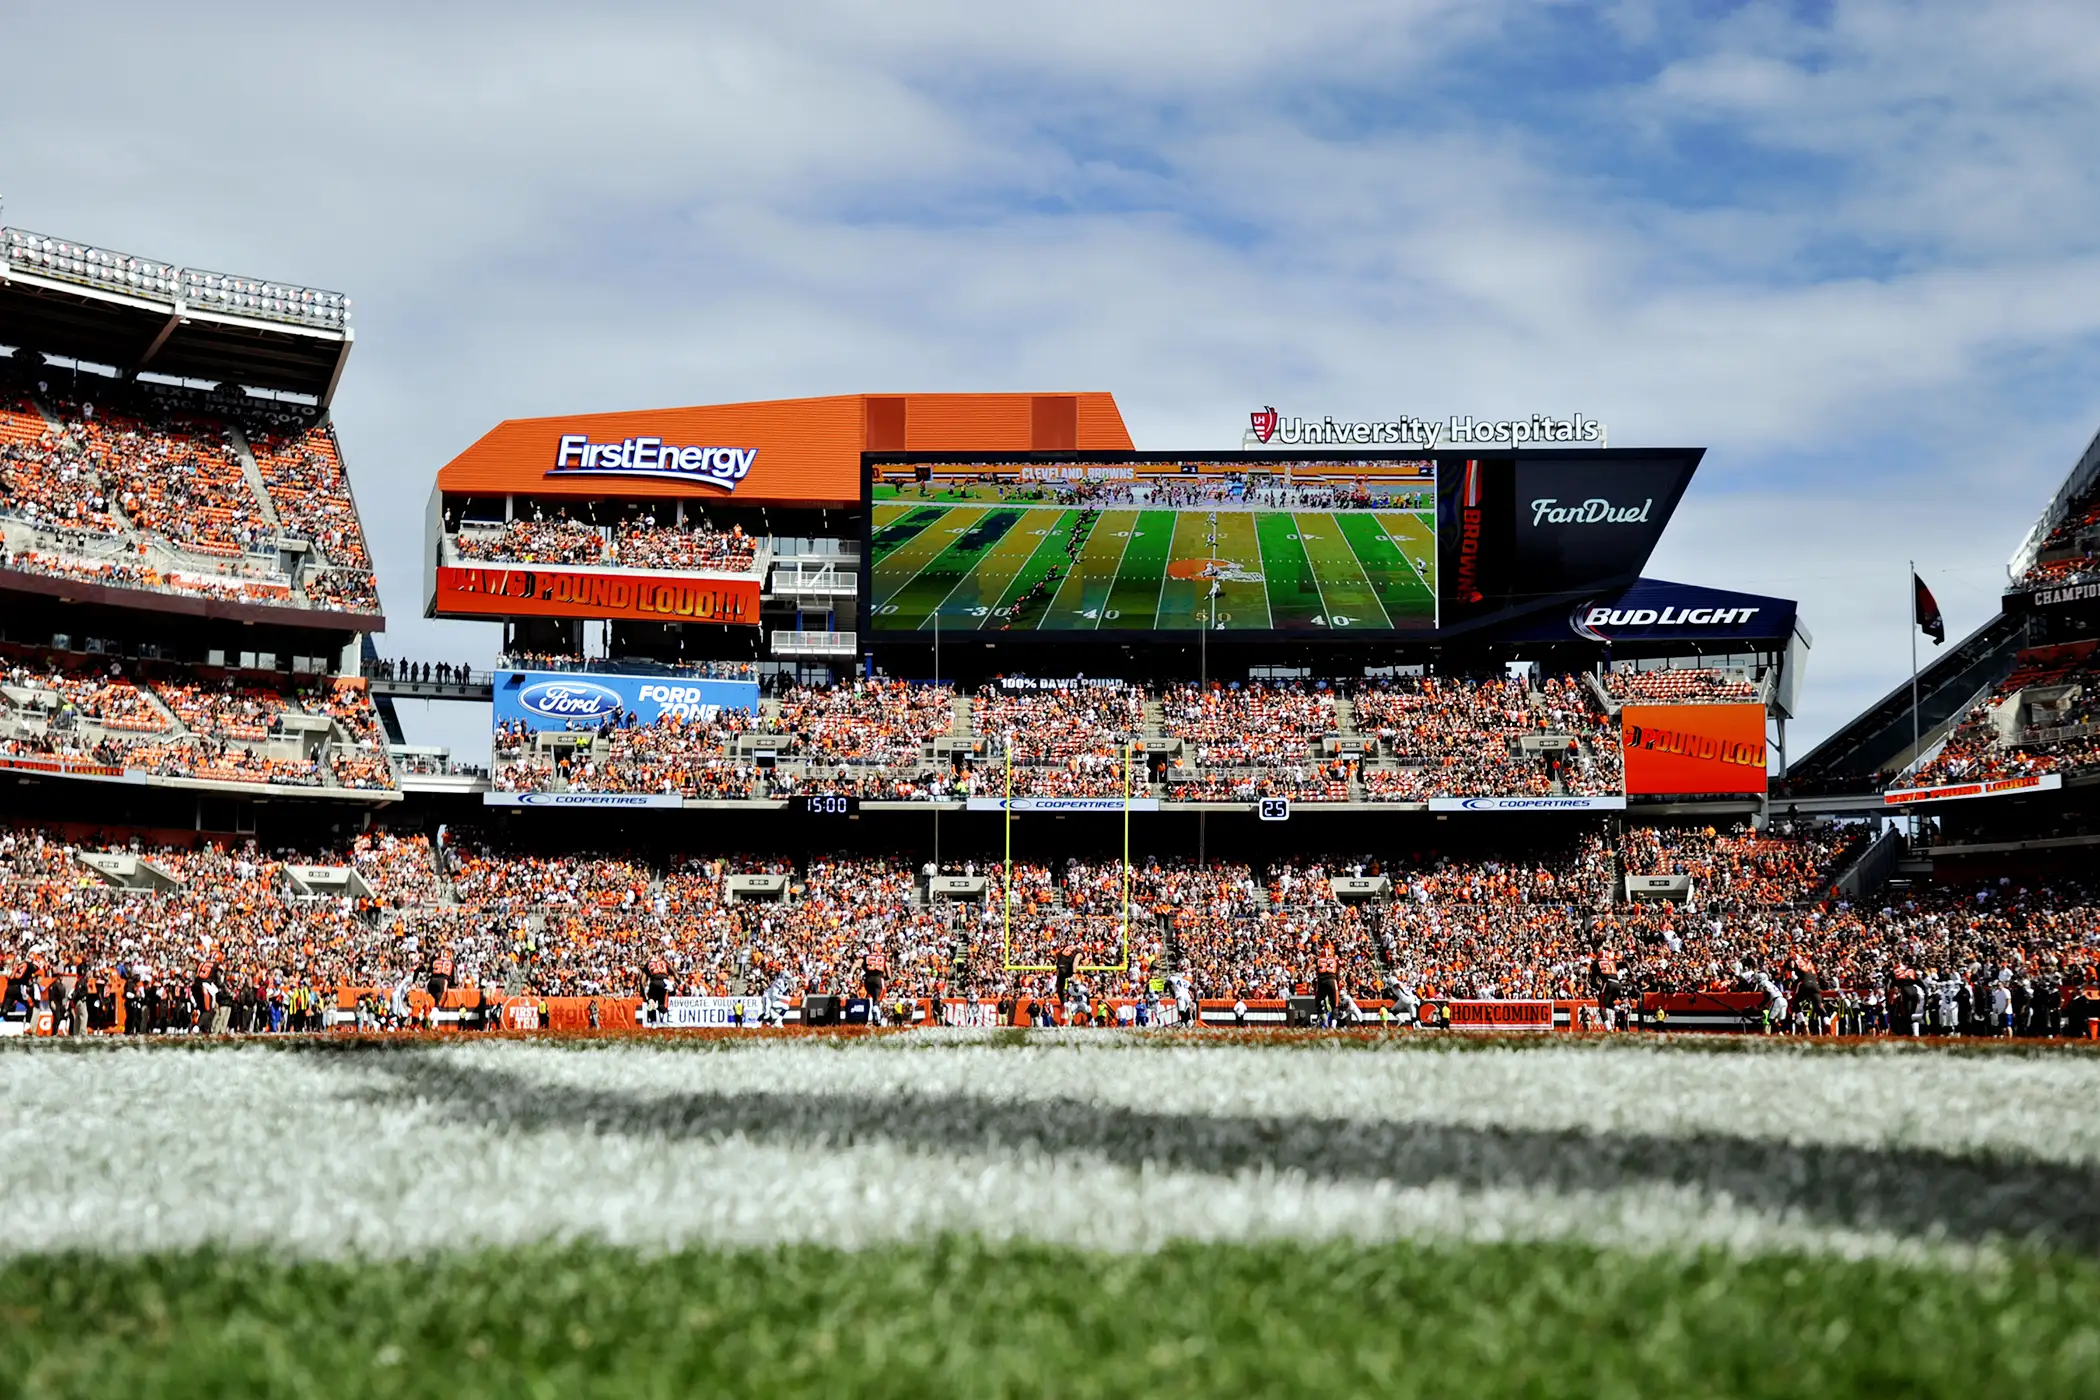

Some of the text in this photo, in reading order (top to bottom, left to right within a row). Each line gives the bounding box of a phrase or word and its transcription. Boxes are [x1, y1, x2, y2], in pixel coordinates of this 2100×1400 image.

[288, 403, 317, 416] TO
[1279, 412, 1598, 450] University Hospitals
[556, 434, 760, 479] FirstEnergy
[1022, 467, 1082, 480] CLEVELAND
[1530, 498, 1653, 527] FanDuel
[535, 573, 631, 609] POUND
[2034, 584, 2100, 606] CHAMPIO
[1585, 606, 1760, 626] BUD LIGHT
[1001, 678, 1037, 689] 100%
[1040, 679, 1078, 689] DAWG
[539, 684, 601, 714] Ford
[638, 685, 701, 704] FORD
[656, 702, 721, 722] ZONE
[555, 796, 648, 805] COOPERTIRES
[807, 797, 847, 813] 15:00
[1264, 801, 1285, 816] 25
[433, 960, 453, 976] 58
[866, 955, 885, 972] 59
[1318, 958, 1337, 973] 53
[1599, 960, 1617, 975] 51
[509, 1006, 539, 1018] FIRST
[680, 1009, 725, 1023] UNITED
[1451, 1005, 1549, 1021] HOMECOMING
[516, 1018, 539, 1030] TEN
